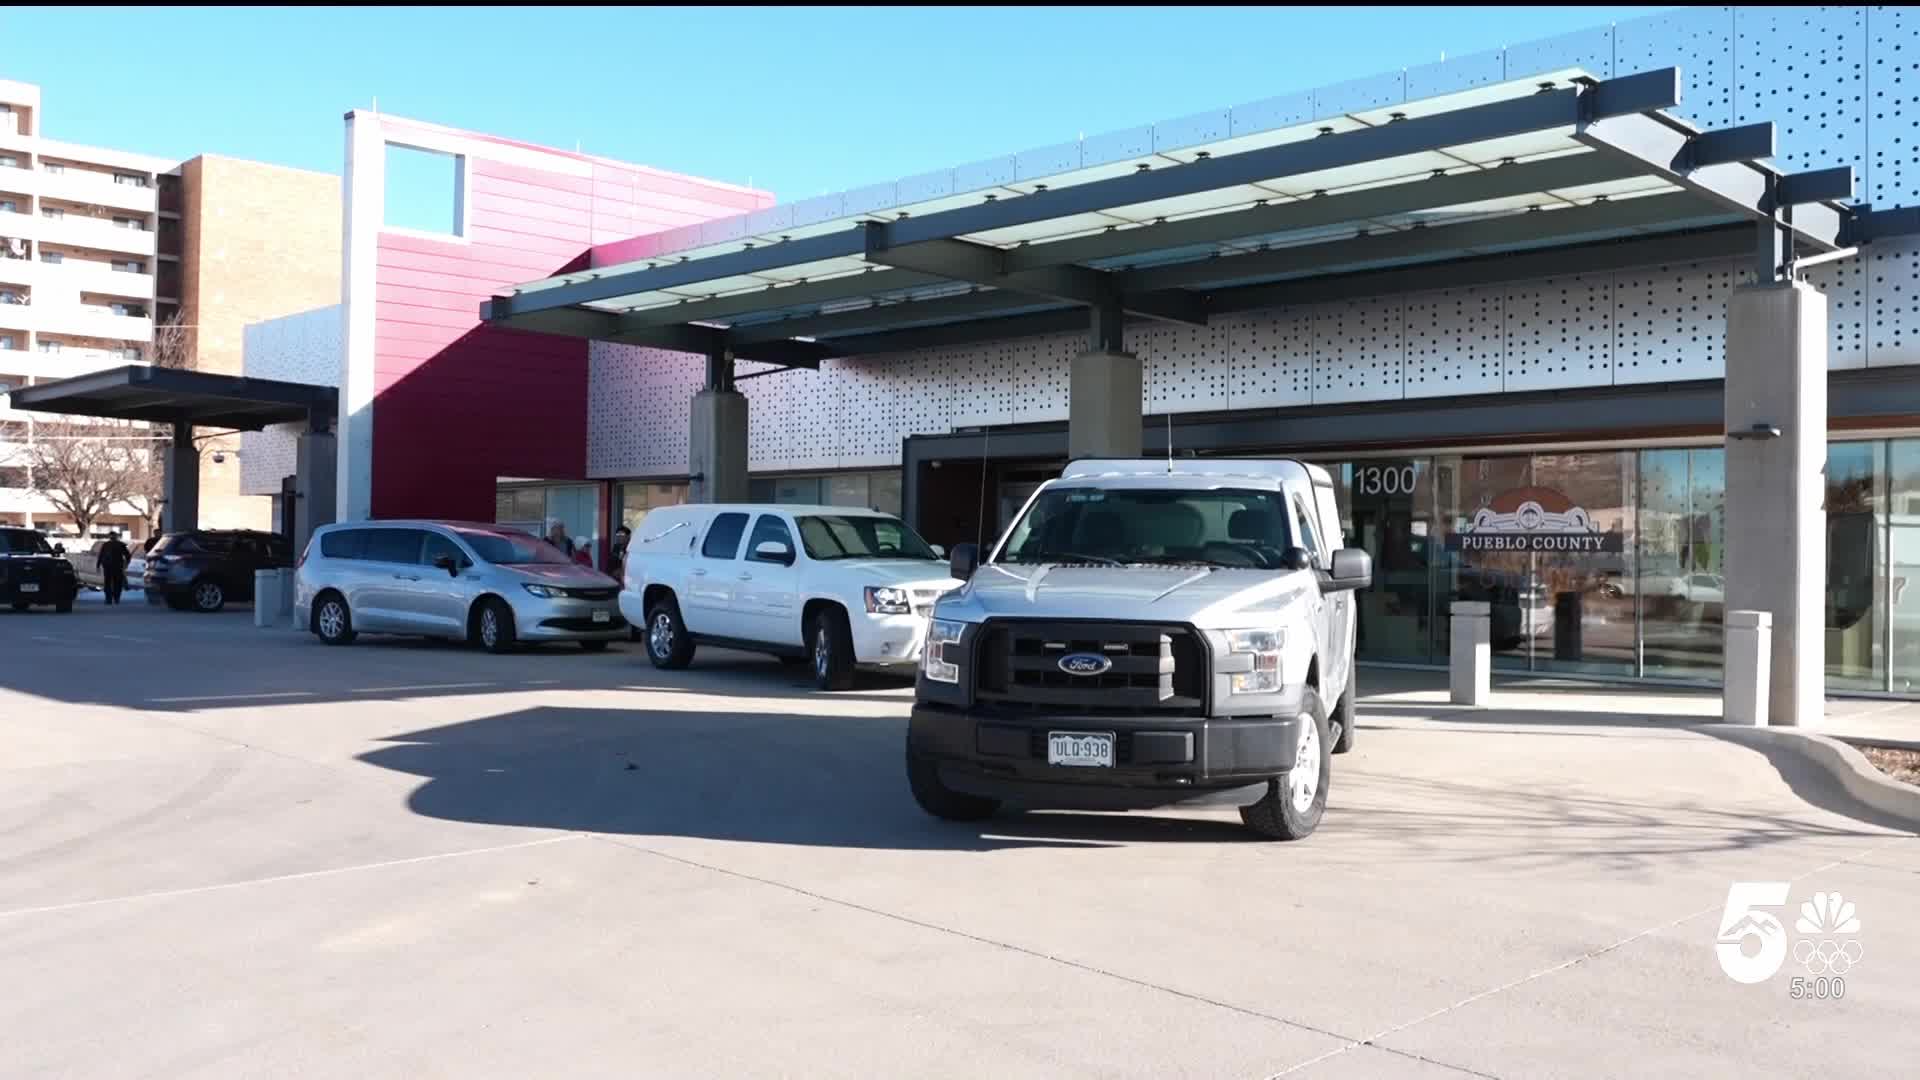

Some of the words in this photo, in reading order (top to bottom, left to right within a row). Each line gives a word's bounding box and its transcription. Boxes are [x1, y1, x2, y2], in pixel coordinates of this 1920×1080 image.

[1355, 466, 1416, 495] 1300
[1462, 536, 1527, 550] PUEBLO
[1533, 536, 1604, 550] COUNTY
[1069, 658, 1097, 671] Ford
